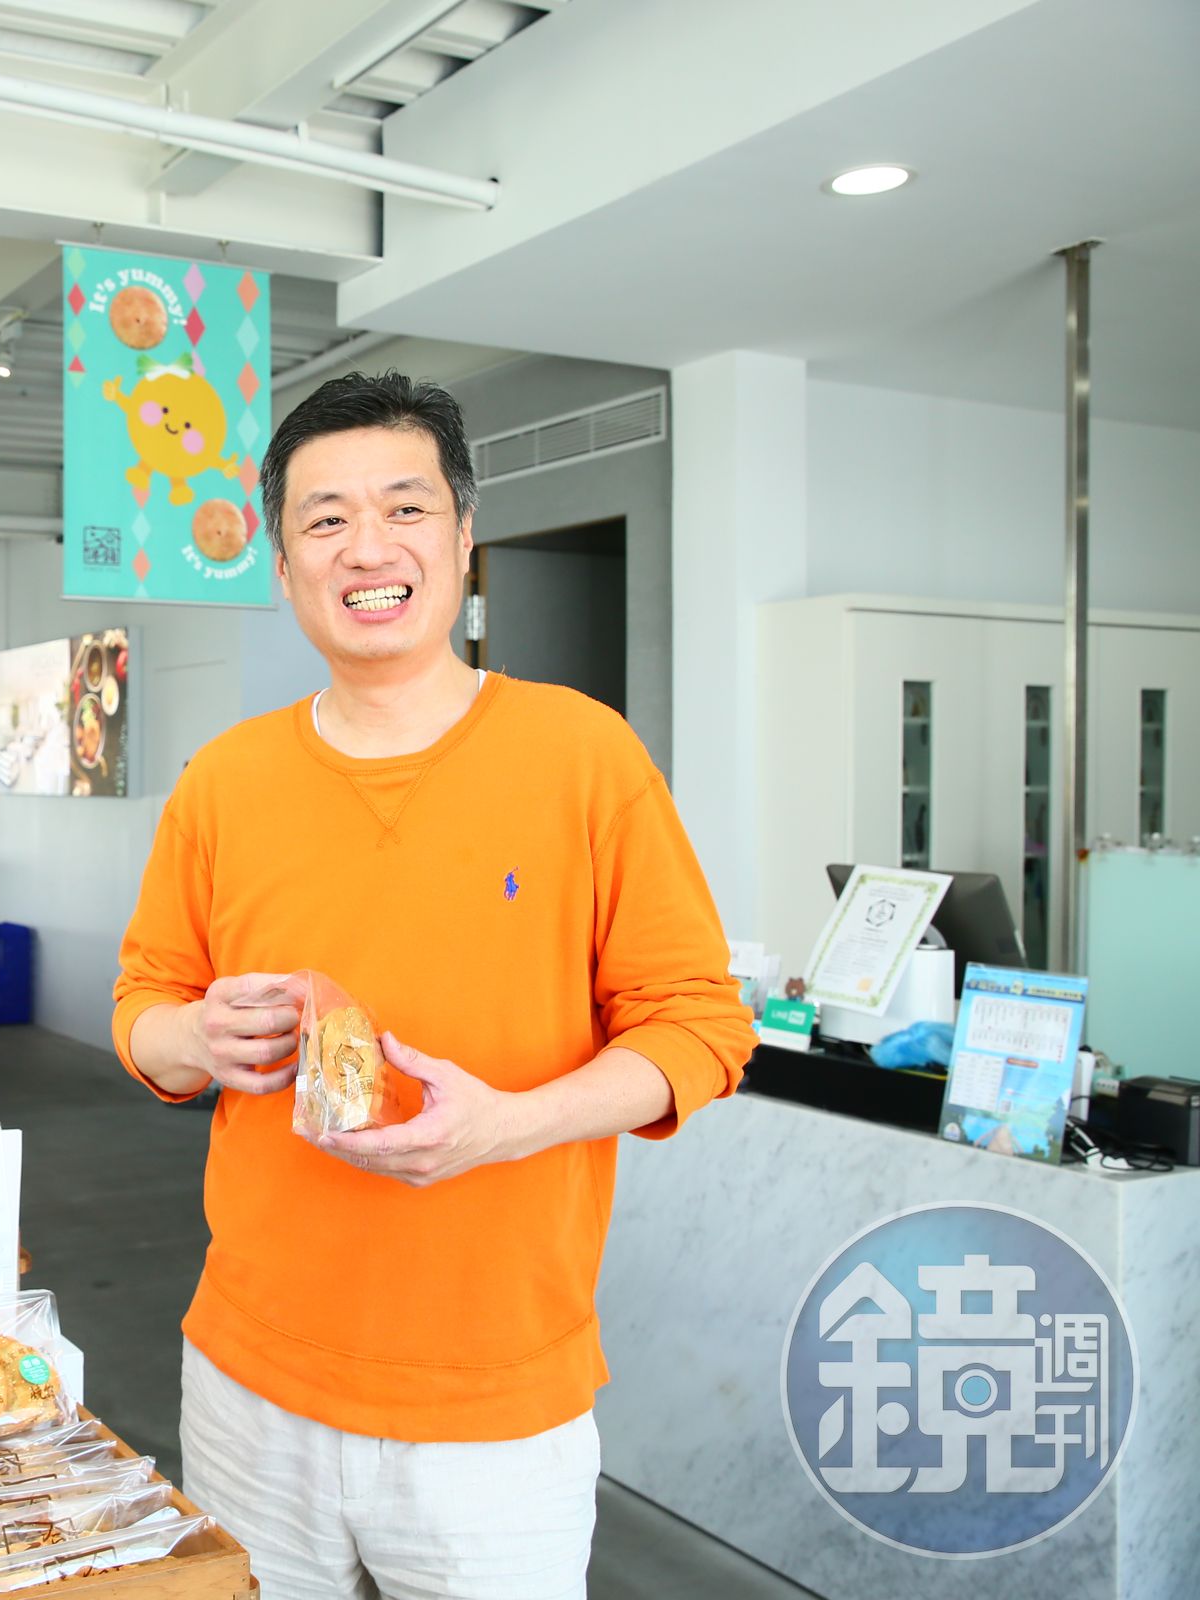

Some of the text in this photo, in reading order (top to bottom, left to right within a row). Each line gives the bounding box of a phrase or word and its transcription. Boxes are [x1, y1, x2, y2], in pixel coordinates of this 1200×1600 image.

[88, 268, 188, 326] It's yummy!
[181, 544, 259, 579] It's yummy!
